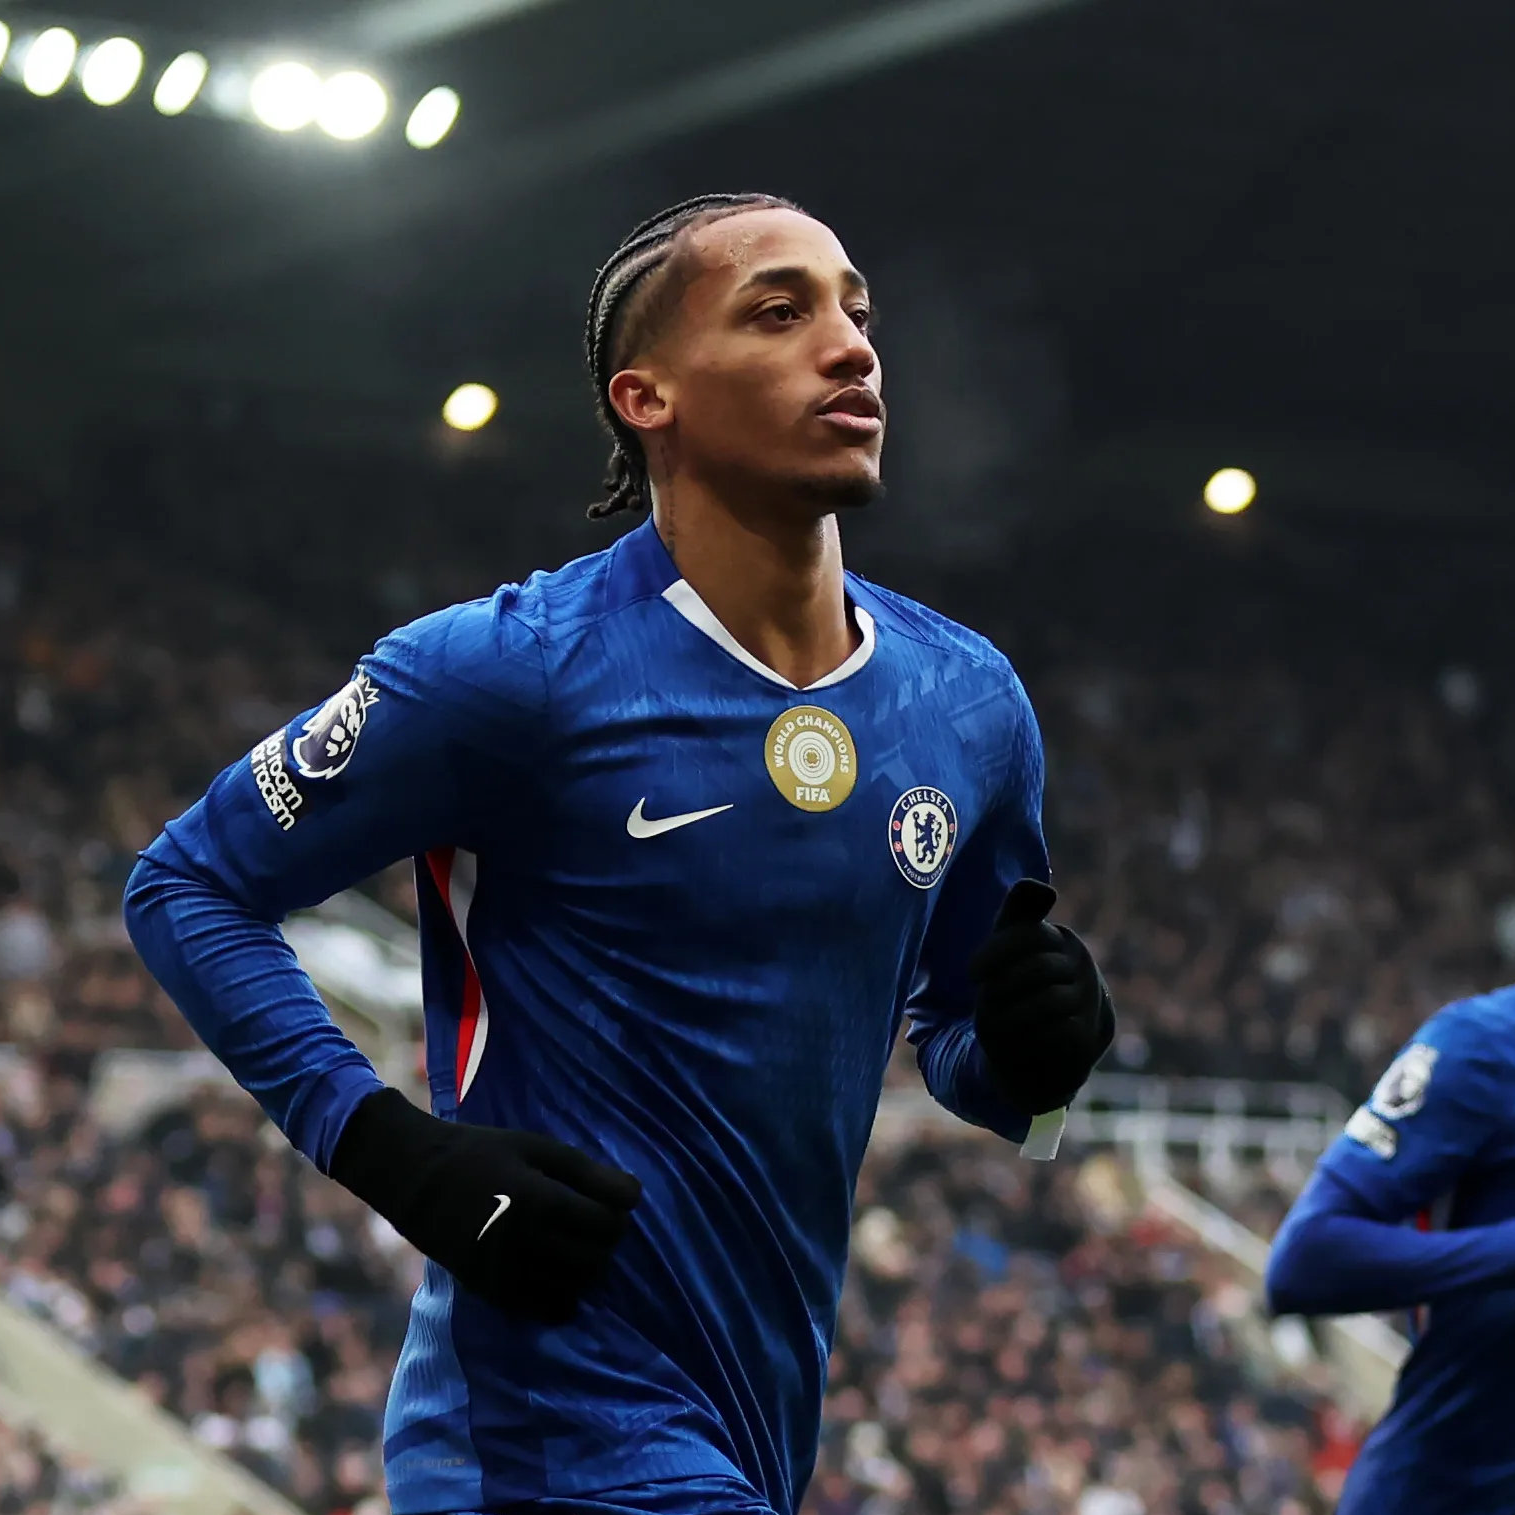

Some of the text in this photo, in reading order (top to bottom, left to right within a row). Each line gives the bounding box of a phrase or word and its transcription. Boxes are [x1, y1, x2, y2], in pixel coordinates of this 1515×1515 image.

[773, 714, 849, 774] WORLD CHAMPIONS
[253, 762, 295, 831] racism
[267, 753, 303, 810] room
[795, 786, 830, 803] FIFA
[901, 790, 948, 813] CHELSEA
